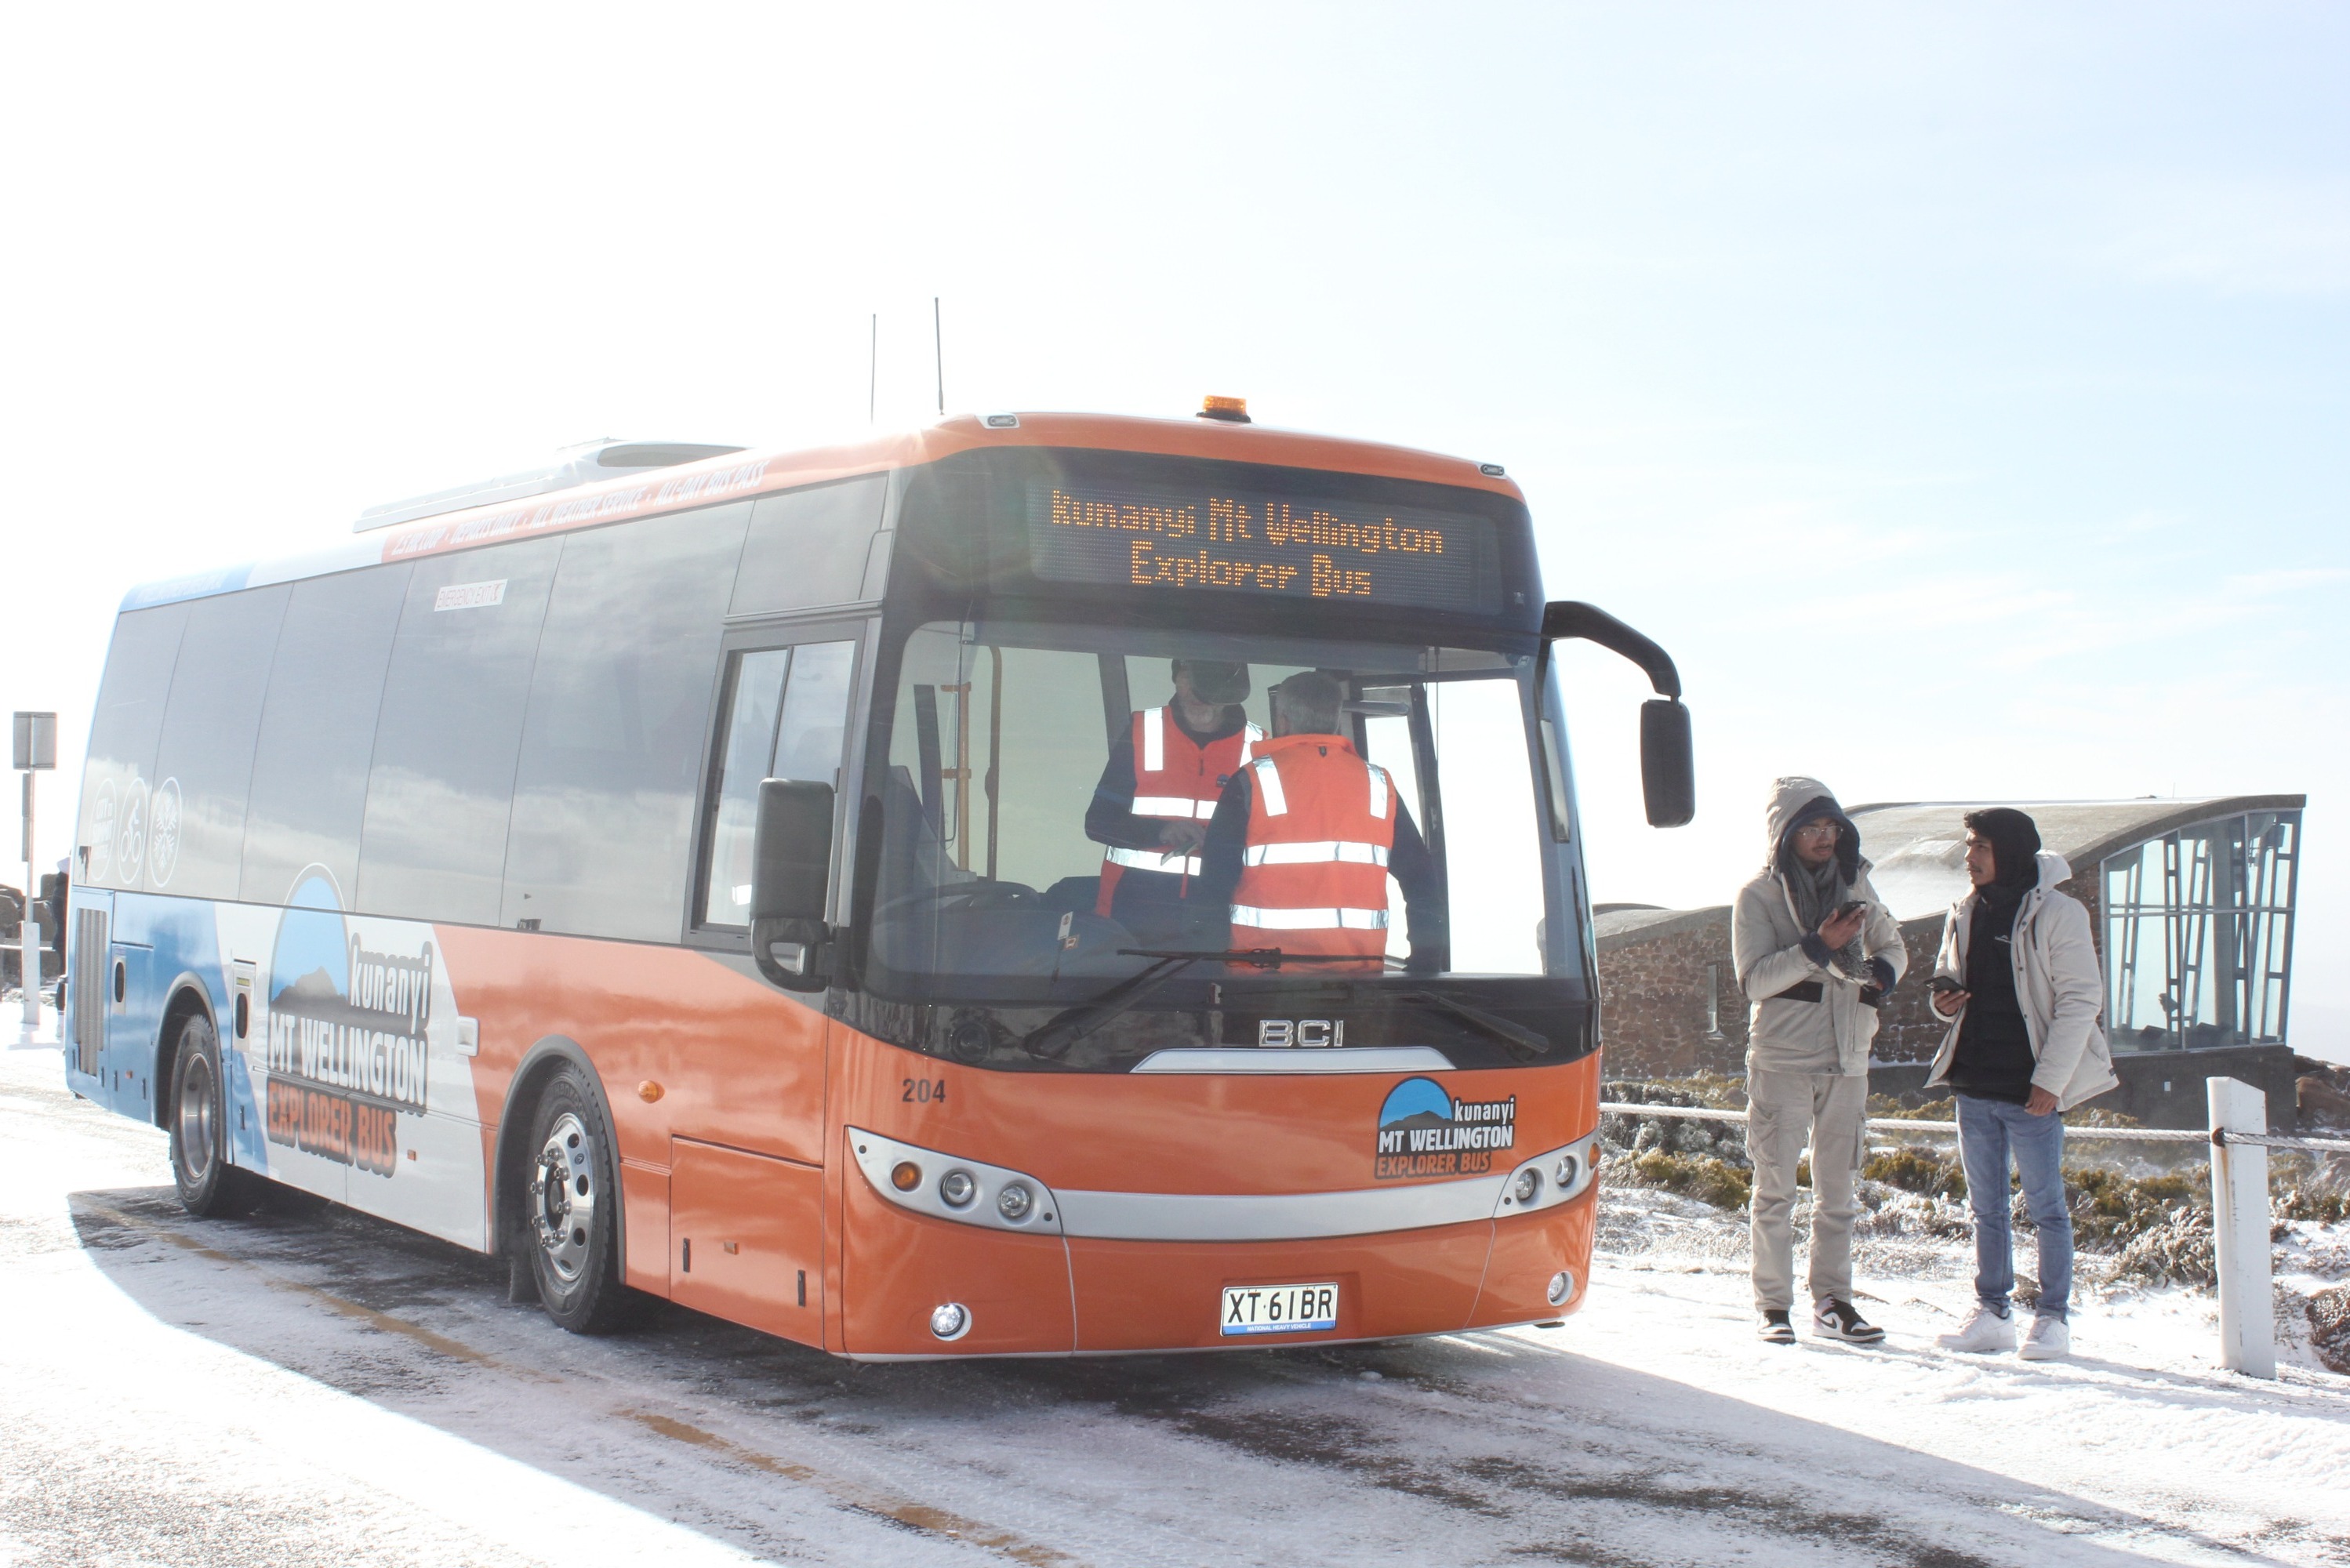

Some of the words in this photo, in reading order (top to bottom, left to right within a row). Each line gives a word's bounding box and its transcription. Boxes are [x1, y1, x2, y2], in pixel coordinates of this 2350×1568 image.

[418, 527, 446, 551] LOOP
[450, 517, 497, 544] DEPARTS
[491, 510, 525, 536] DAILY
[530, 506, 553, 529] ALL
[550, 495, 603, 525] WEATHER
[598, 485, 648, 515] SERVICE
[653, 475, 708, 506] ALL-DAY
[704, 468, 732, 496] BUS
[729, 463, 768, 491] PASS
[1209, 497, 1252, 542] Mt
[1266, 503, 1443, 554] Wellington
[1131, 540, 1298, 587] Explorer
[1312, 553, 1371, 597] Bus
[438, 588, 478, 608] EMERGENCY
[474, 585, 492, 604] EXIT
[351, 945, 429, 1034] kunanyi
[1259, 1019, 1344, 1047] BCI
[270, 1011, 296, 1073] MT
[301, 1017, 426, 1106] WELLINGTON
[903, 1078, 946, 1103] 204
[1455, 1098, 1515, 1125] kunanyi
[269, 1082, 352, 1157] EXPLORER
[358, 1105, 394, 1169] BUS
[1378, 1130, 1404, 1153] MT
[1410, 1124, 1513, 1152] WELLINGTON
[1377, 1153, 1457, 1177] EXPLORER
[1460, 1152, 1491, 1172] BUS
